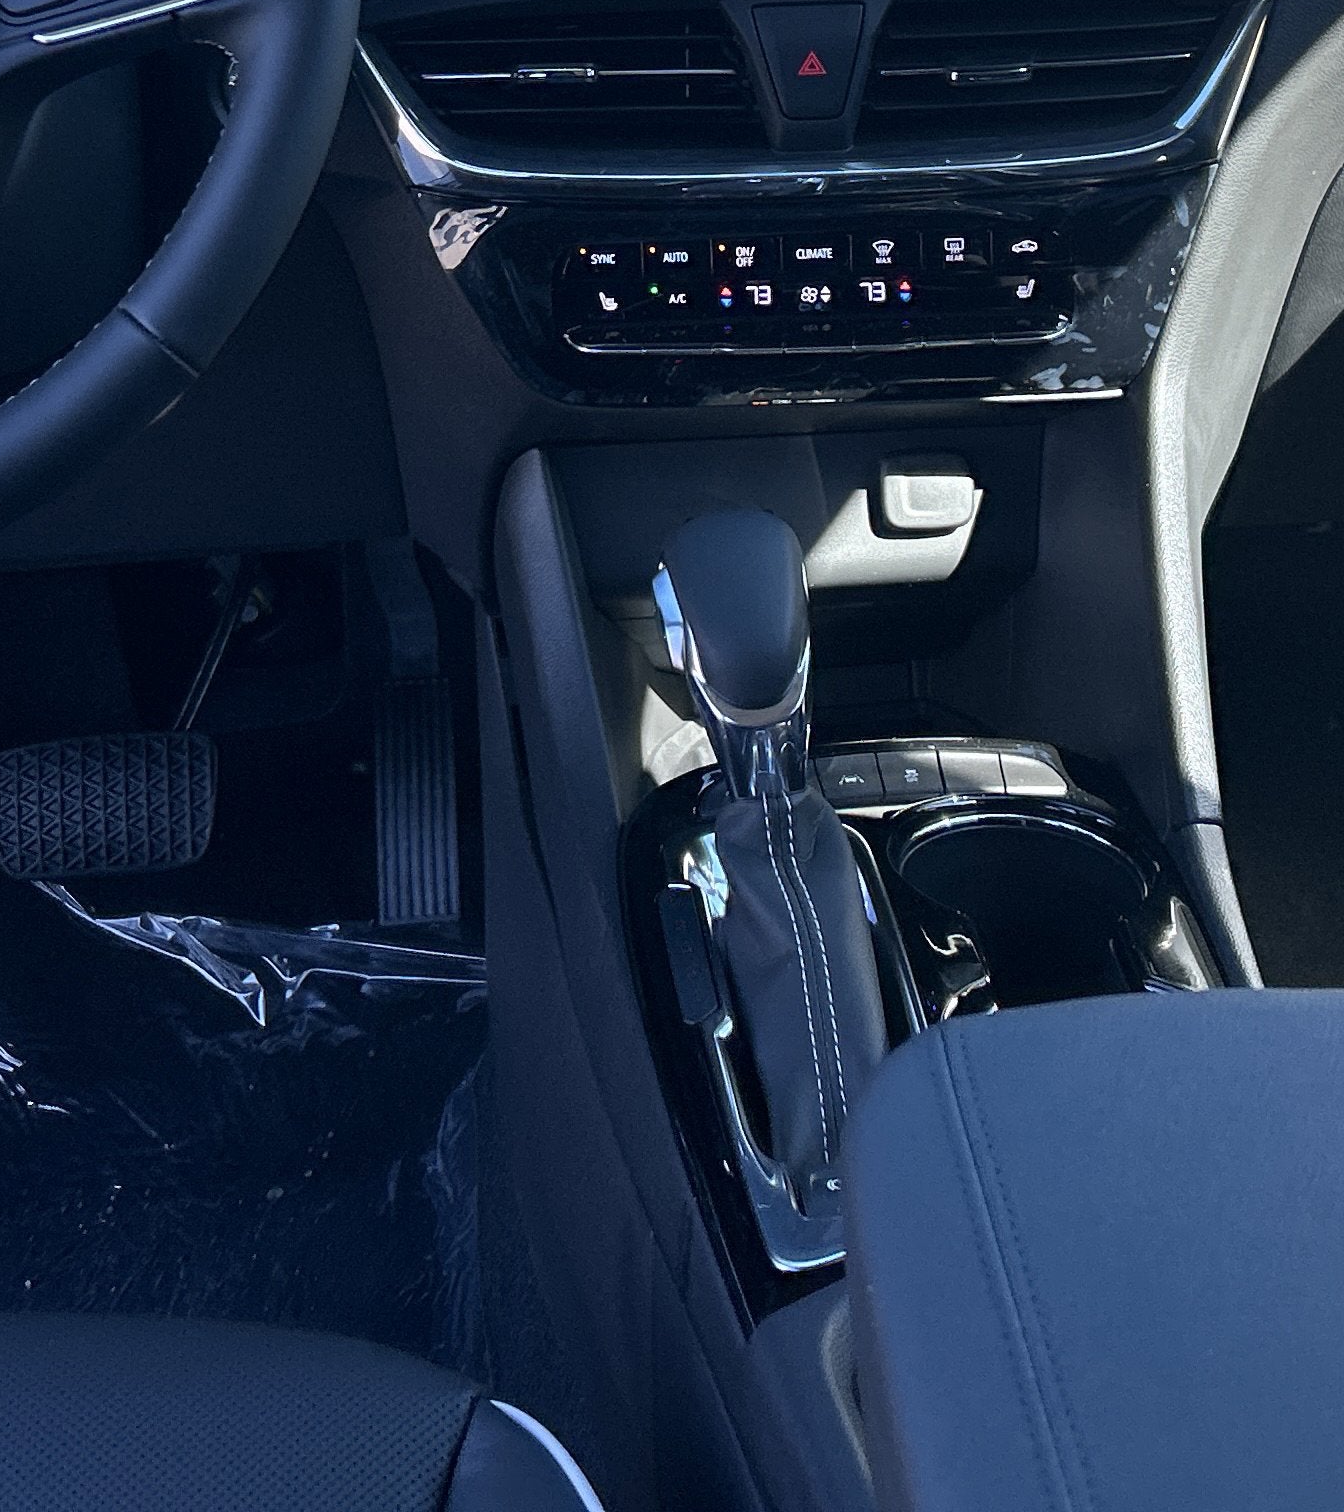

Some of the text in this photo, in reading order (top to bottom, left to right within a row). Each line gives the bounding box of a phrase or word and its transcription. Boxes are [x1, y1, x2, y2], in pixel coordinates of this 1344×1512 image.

[662, 251, 689, 263] AUTO
[735, 246, 756, 257] ON/
[795, 247, 834, 260] CLIMATE
[945, 253, 964, 262] REAR
[590, 253, 616, 265] SYNC
[735, 255, 754, 268] OFF
[875, 256, 892, 264] MAX
[745, 285, 772, 305] 73
[858, 281, 886, 302] 73
[668, 293, 687, 304] A/C
